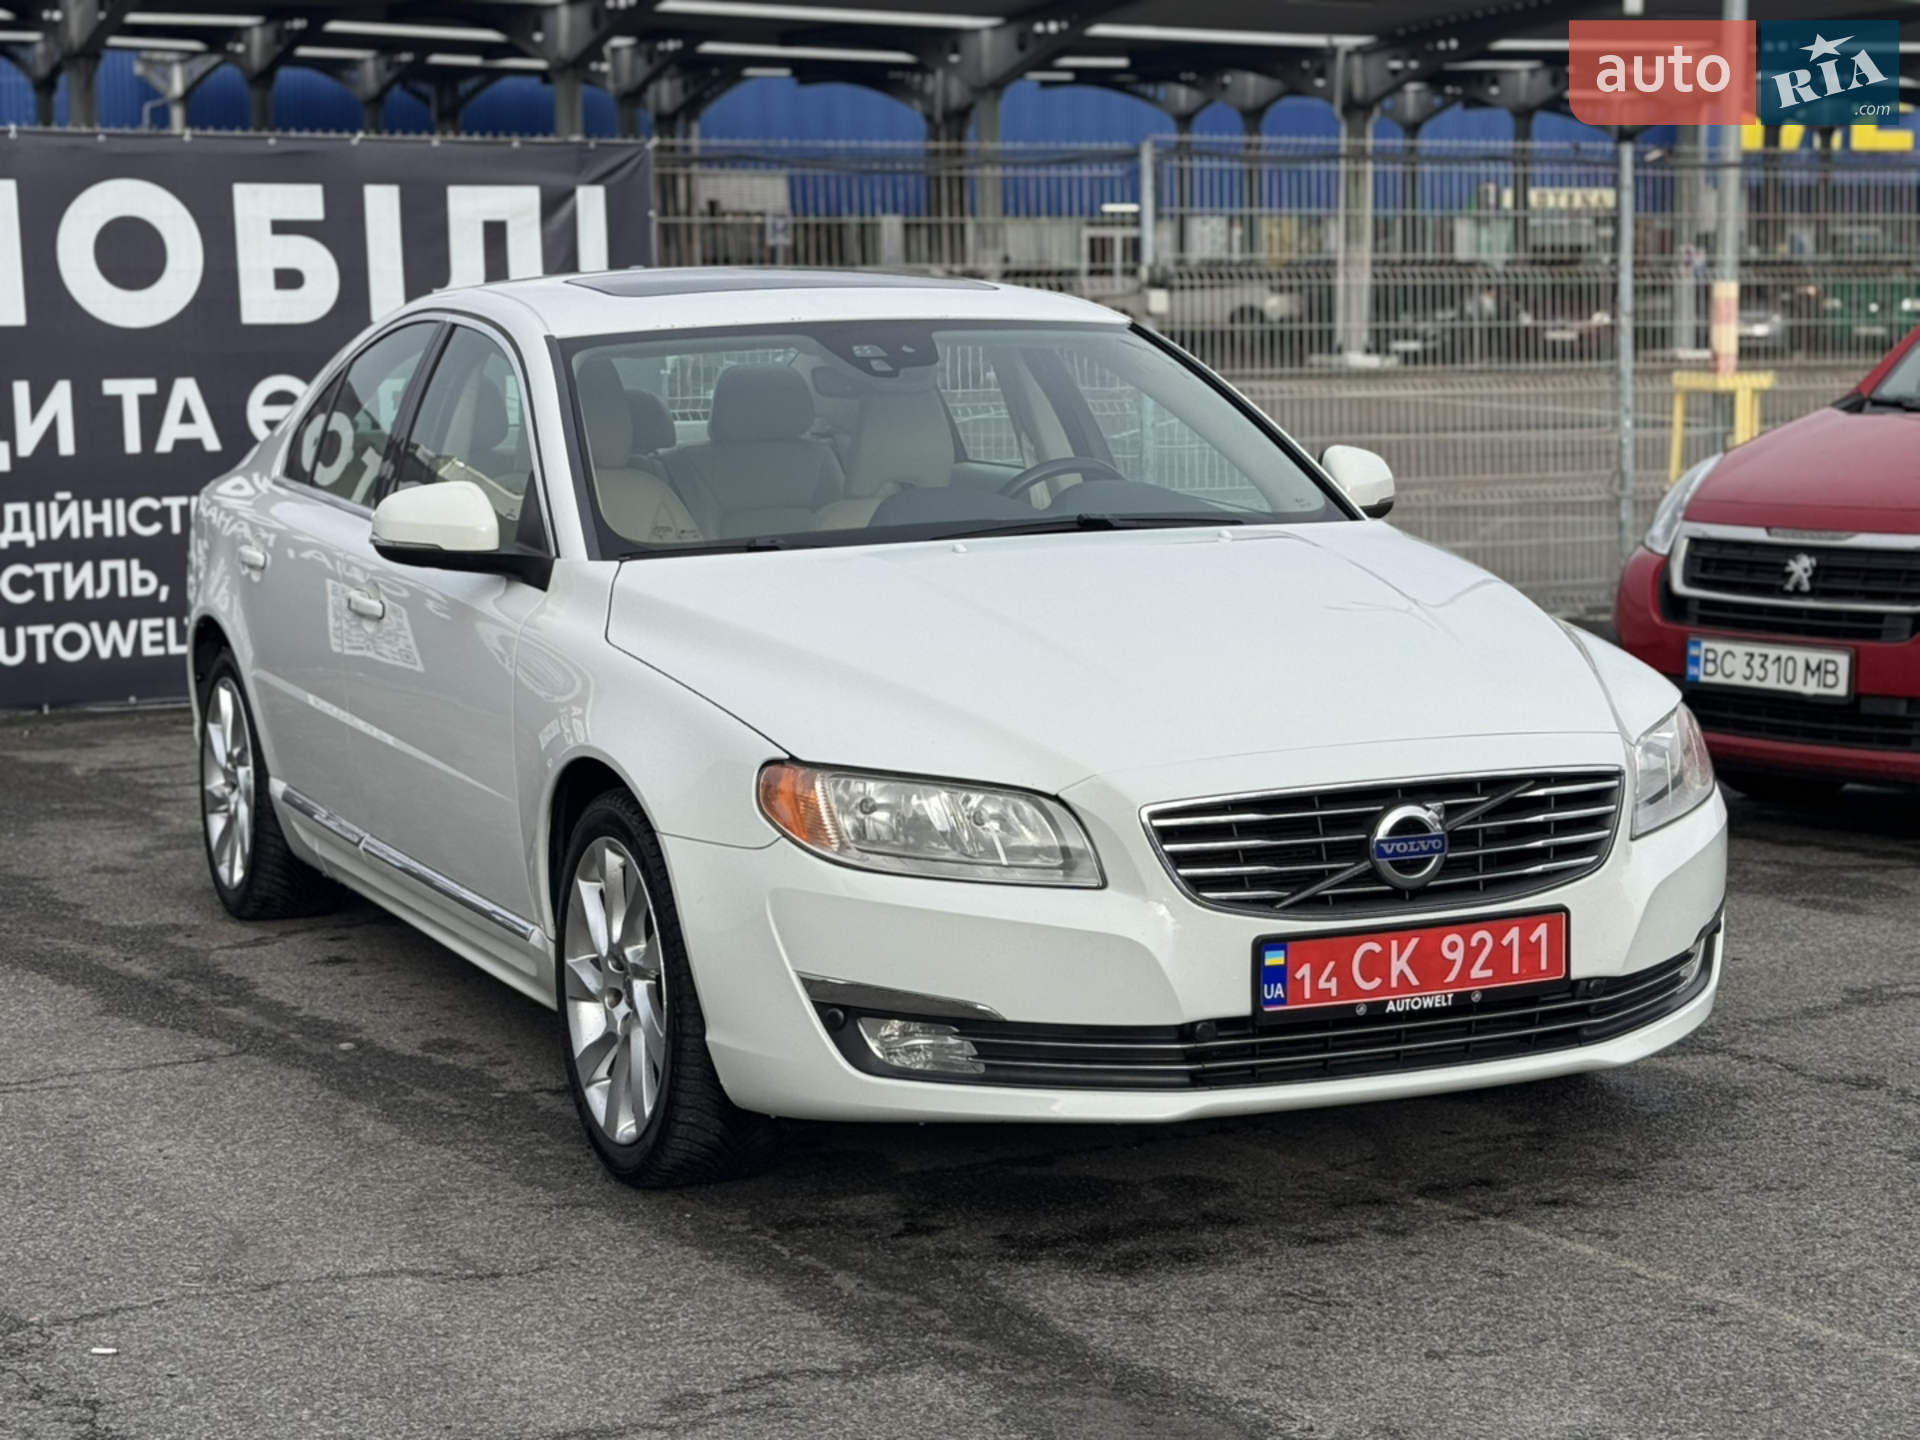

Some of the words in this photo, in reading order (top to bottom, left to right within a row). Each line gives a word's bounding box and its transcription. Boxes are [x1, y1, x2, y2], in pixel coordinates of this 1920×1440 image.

[0, 177, 609, 329] ОБІЛІ
[0, 379, 76, 473] И
[102, 376, 223, 454] ТА
[0, 490, 199, 550] ДІЙНІСТ
[0, 558, 170, 604] СТИЛЬ,
[0, 616, 189, 667] UTOWEL
[1703, 648, 1737, 679] BC
[1741, 652, 1797, 686] 3310
[1803, 657, 1840, 690] MB
[1380, 837, 1443, 855] VOLVO
[1294, 960, 1338, 1000] 14
[1351, 936, 1421, 991] CK
[1440, 922, 1549, 983] 9211
[1263, 983, 1285, 1000] UA
[1385, 993, 1454, 1014] AUTOWELT
